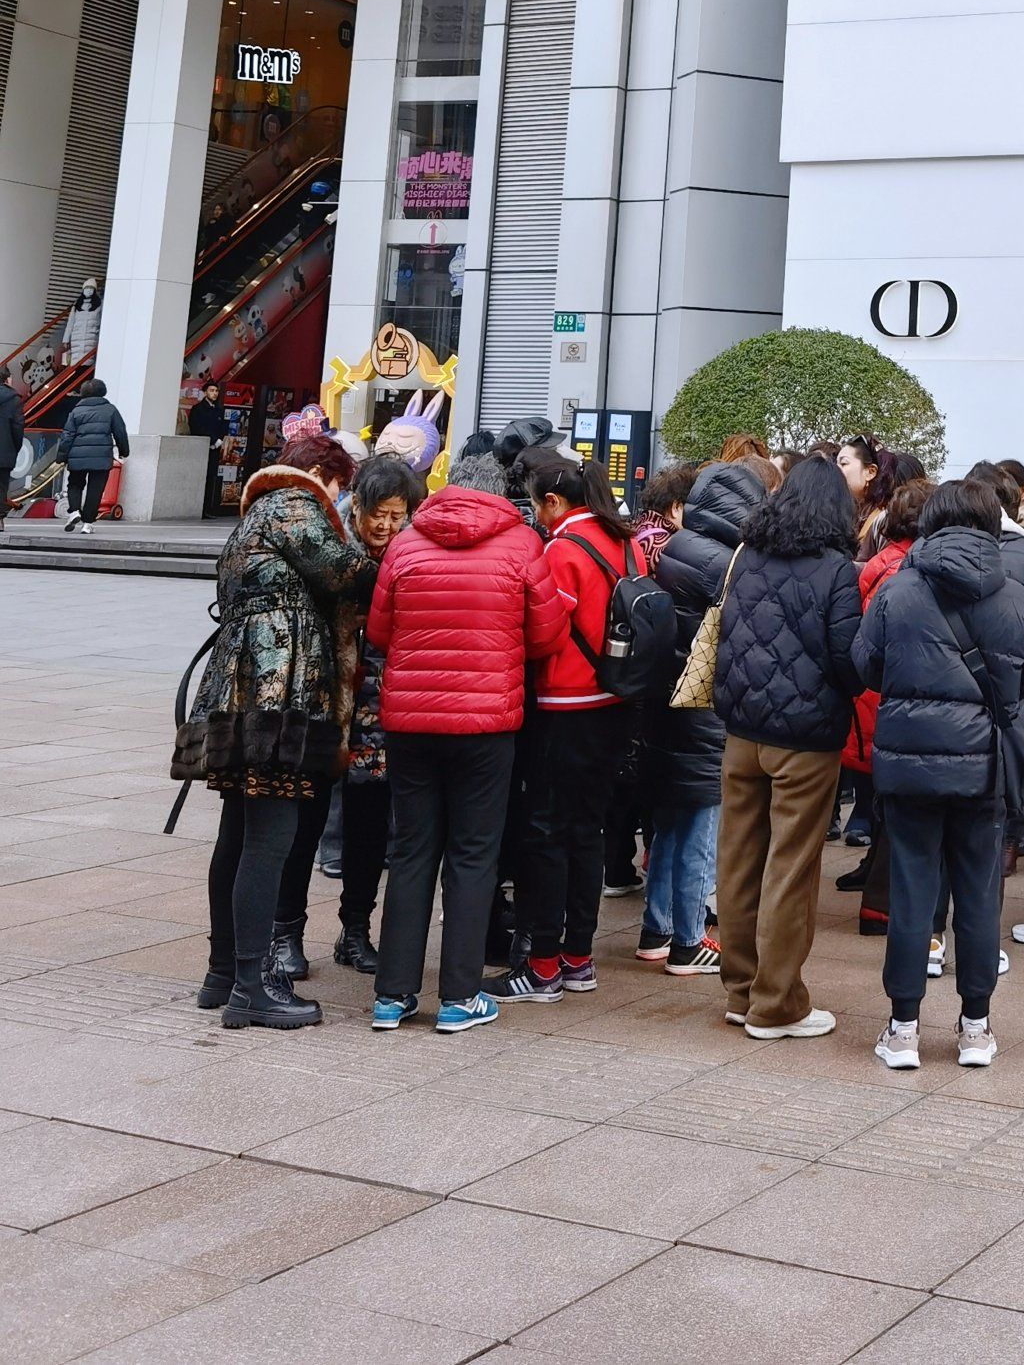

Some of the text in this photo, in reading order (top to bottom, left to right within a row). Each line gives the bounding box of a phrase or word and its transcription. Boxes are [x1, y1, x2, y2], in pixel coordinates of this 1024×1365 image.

[410, 182, 425, 190] THE
[557, 315, 574, 326] 829
[284, 418, 321, 435] MISCHIE
